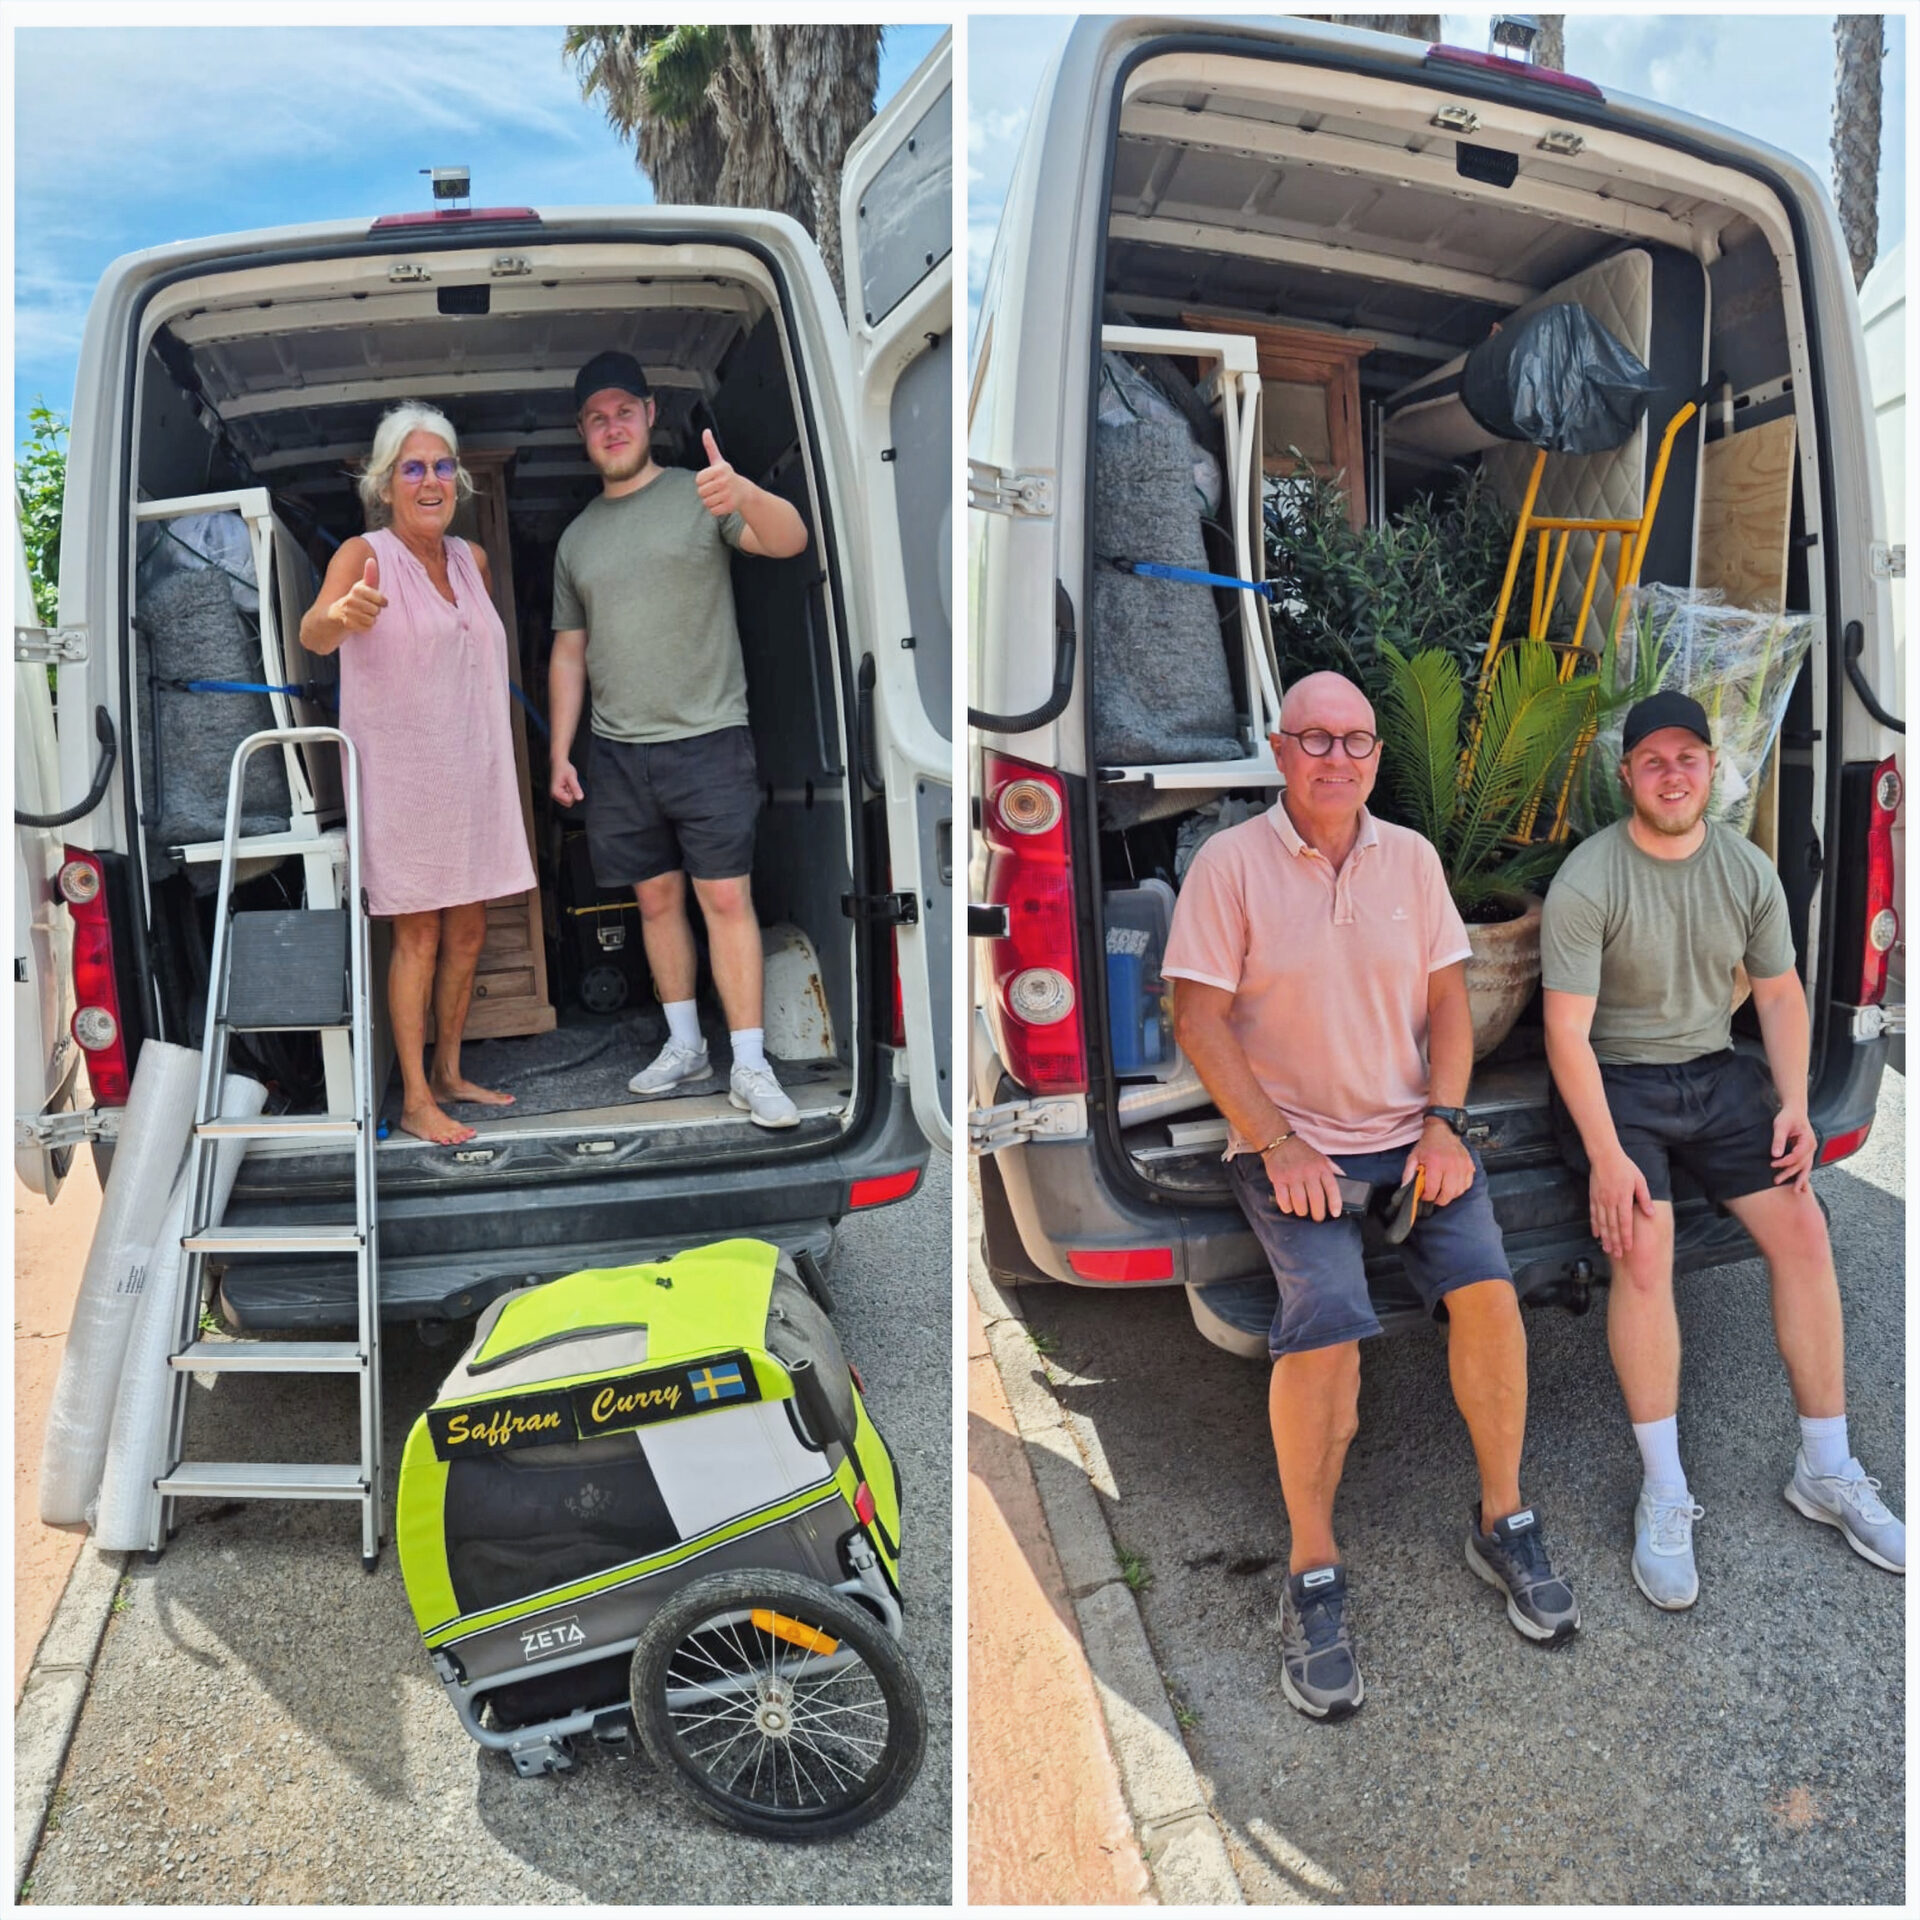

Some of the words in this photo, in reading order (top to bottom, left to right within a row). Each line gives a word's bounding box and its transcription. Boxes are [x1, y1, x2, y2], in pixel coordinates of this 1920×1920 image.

[447, 1409, 561, 1447] Saffran
[590, 1384, 682, 1423] Curry
[520, 1623, 586, 1653] ZETA
